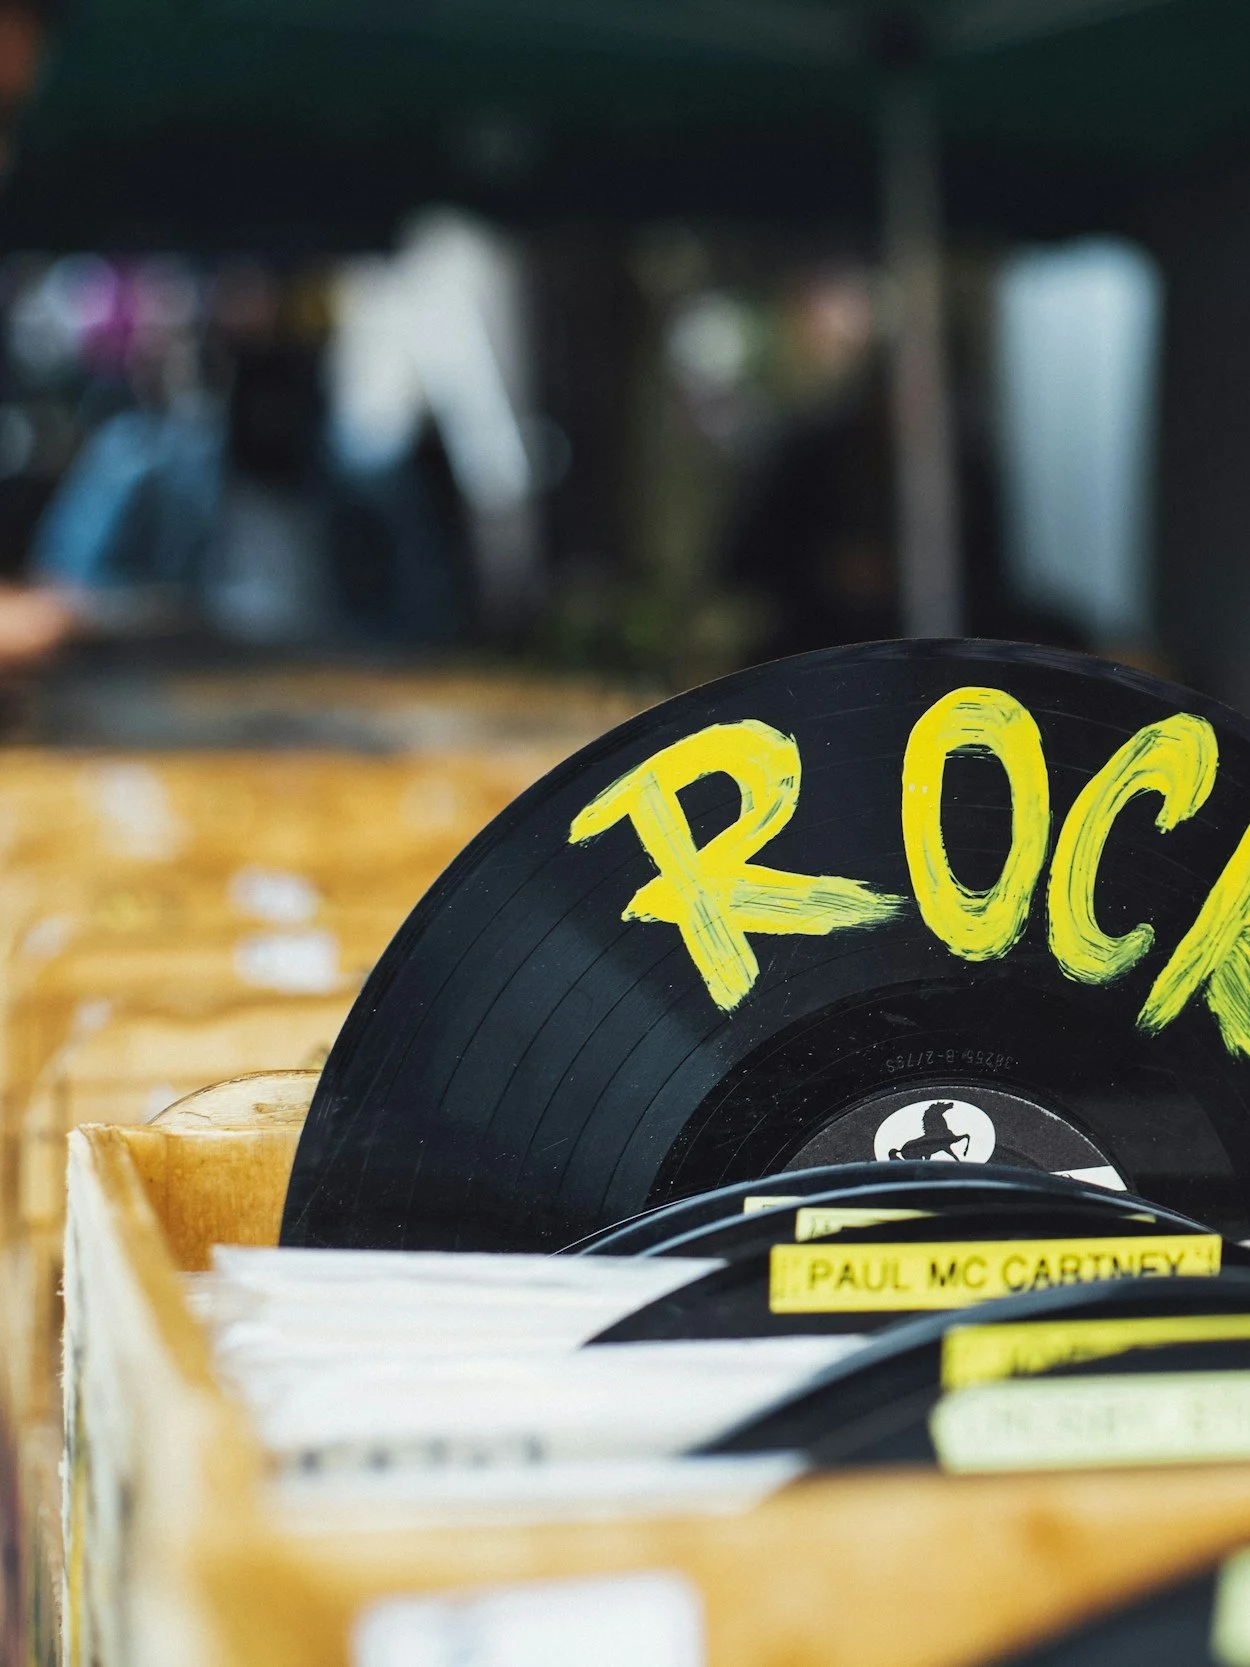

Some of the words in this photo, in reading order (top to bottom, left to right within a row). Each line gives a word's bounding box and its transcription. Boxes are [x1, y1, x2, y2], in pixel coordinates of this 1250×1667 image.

[808, 1259, 913, 1292] PAUL
[930, 1258, 989, 1290] MC
[1001, 1251, 1185, 1293] CARTNEY
